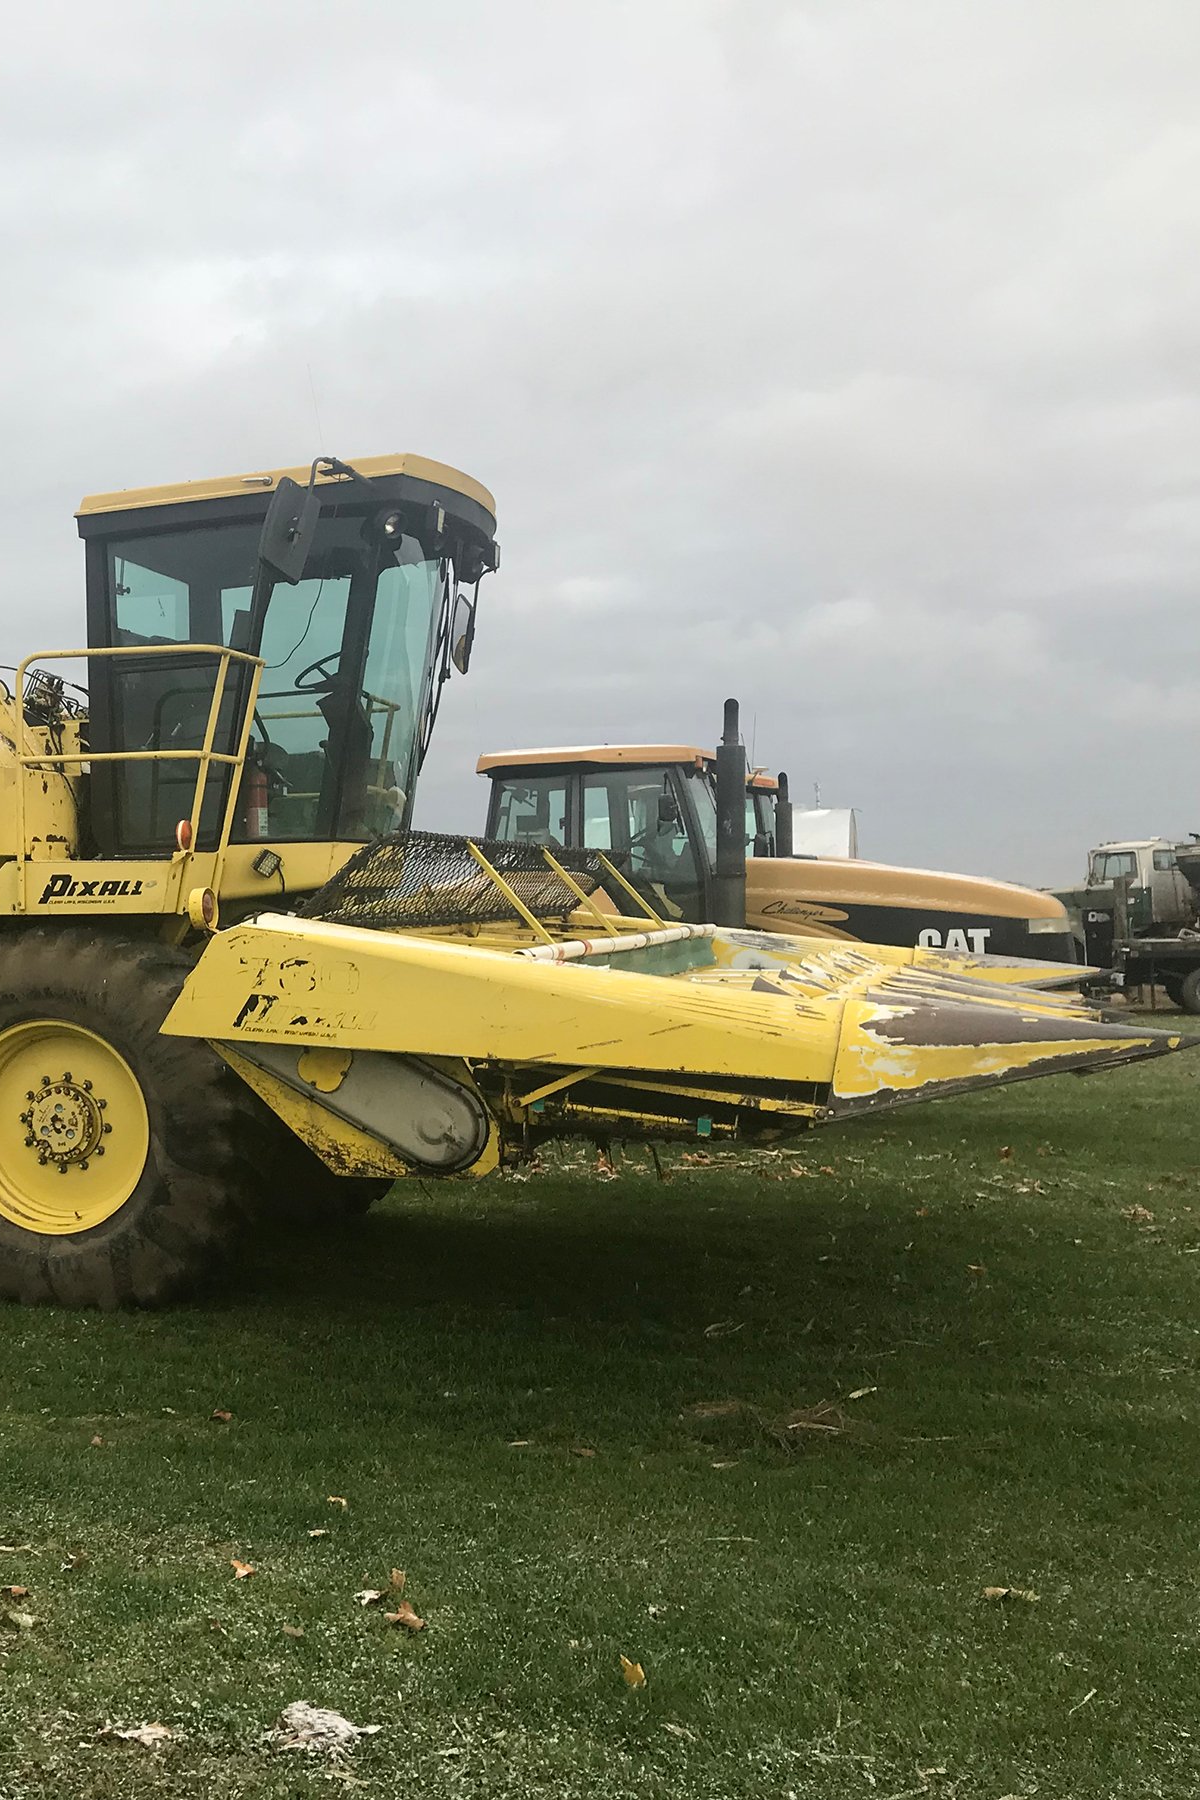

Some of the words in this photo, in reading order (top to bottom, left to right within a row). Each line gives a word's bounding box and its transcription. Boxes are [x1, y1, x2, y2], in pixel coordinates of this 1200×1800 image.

[38, 874, 143, 904] PIXALL
[761, 900, 825, 920] Challenger
[918, 928, 991, 954] CAT
